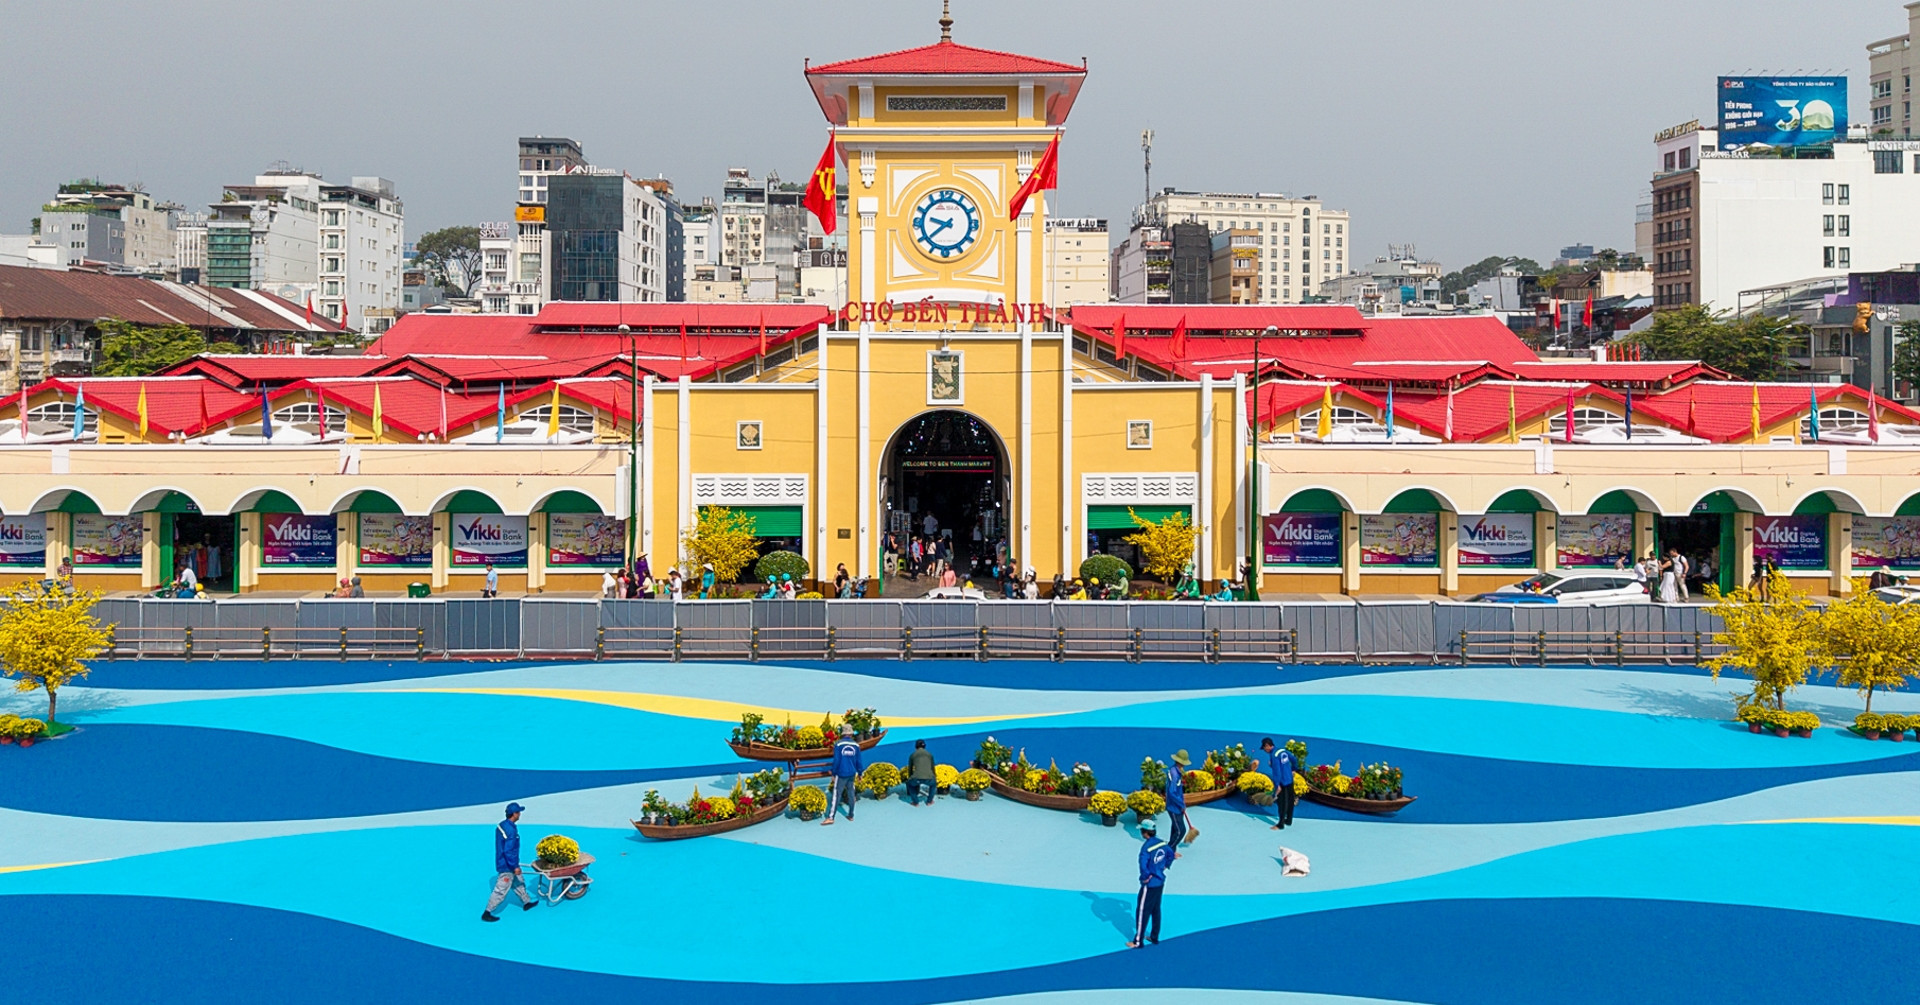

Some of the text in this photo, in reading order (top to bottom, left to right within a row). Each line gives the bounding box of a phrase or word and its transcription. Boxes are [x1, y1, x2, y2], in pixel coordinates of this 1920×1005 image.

[1775, 100, 1834, 132] 30
[1732, 151, 1749, 159] BAR
[556, 165, 597, 175] AVANTI
[845, 295, 1045, 325] CHỢ BẾN THÀNH
[0, 523, 23, 540] kki
[268, 517, 312, 540] Vikki
[458, 517, 501, 540] Vikki
[1269, 516, 1312, 540] Vikki
[1463, 517, 1506, 540] Vikki
[1755, 519, 1798, 542] Vikki
